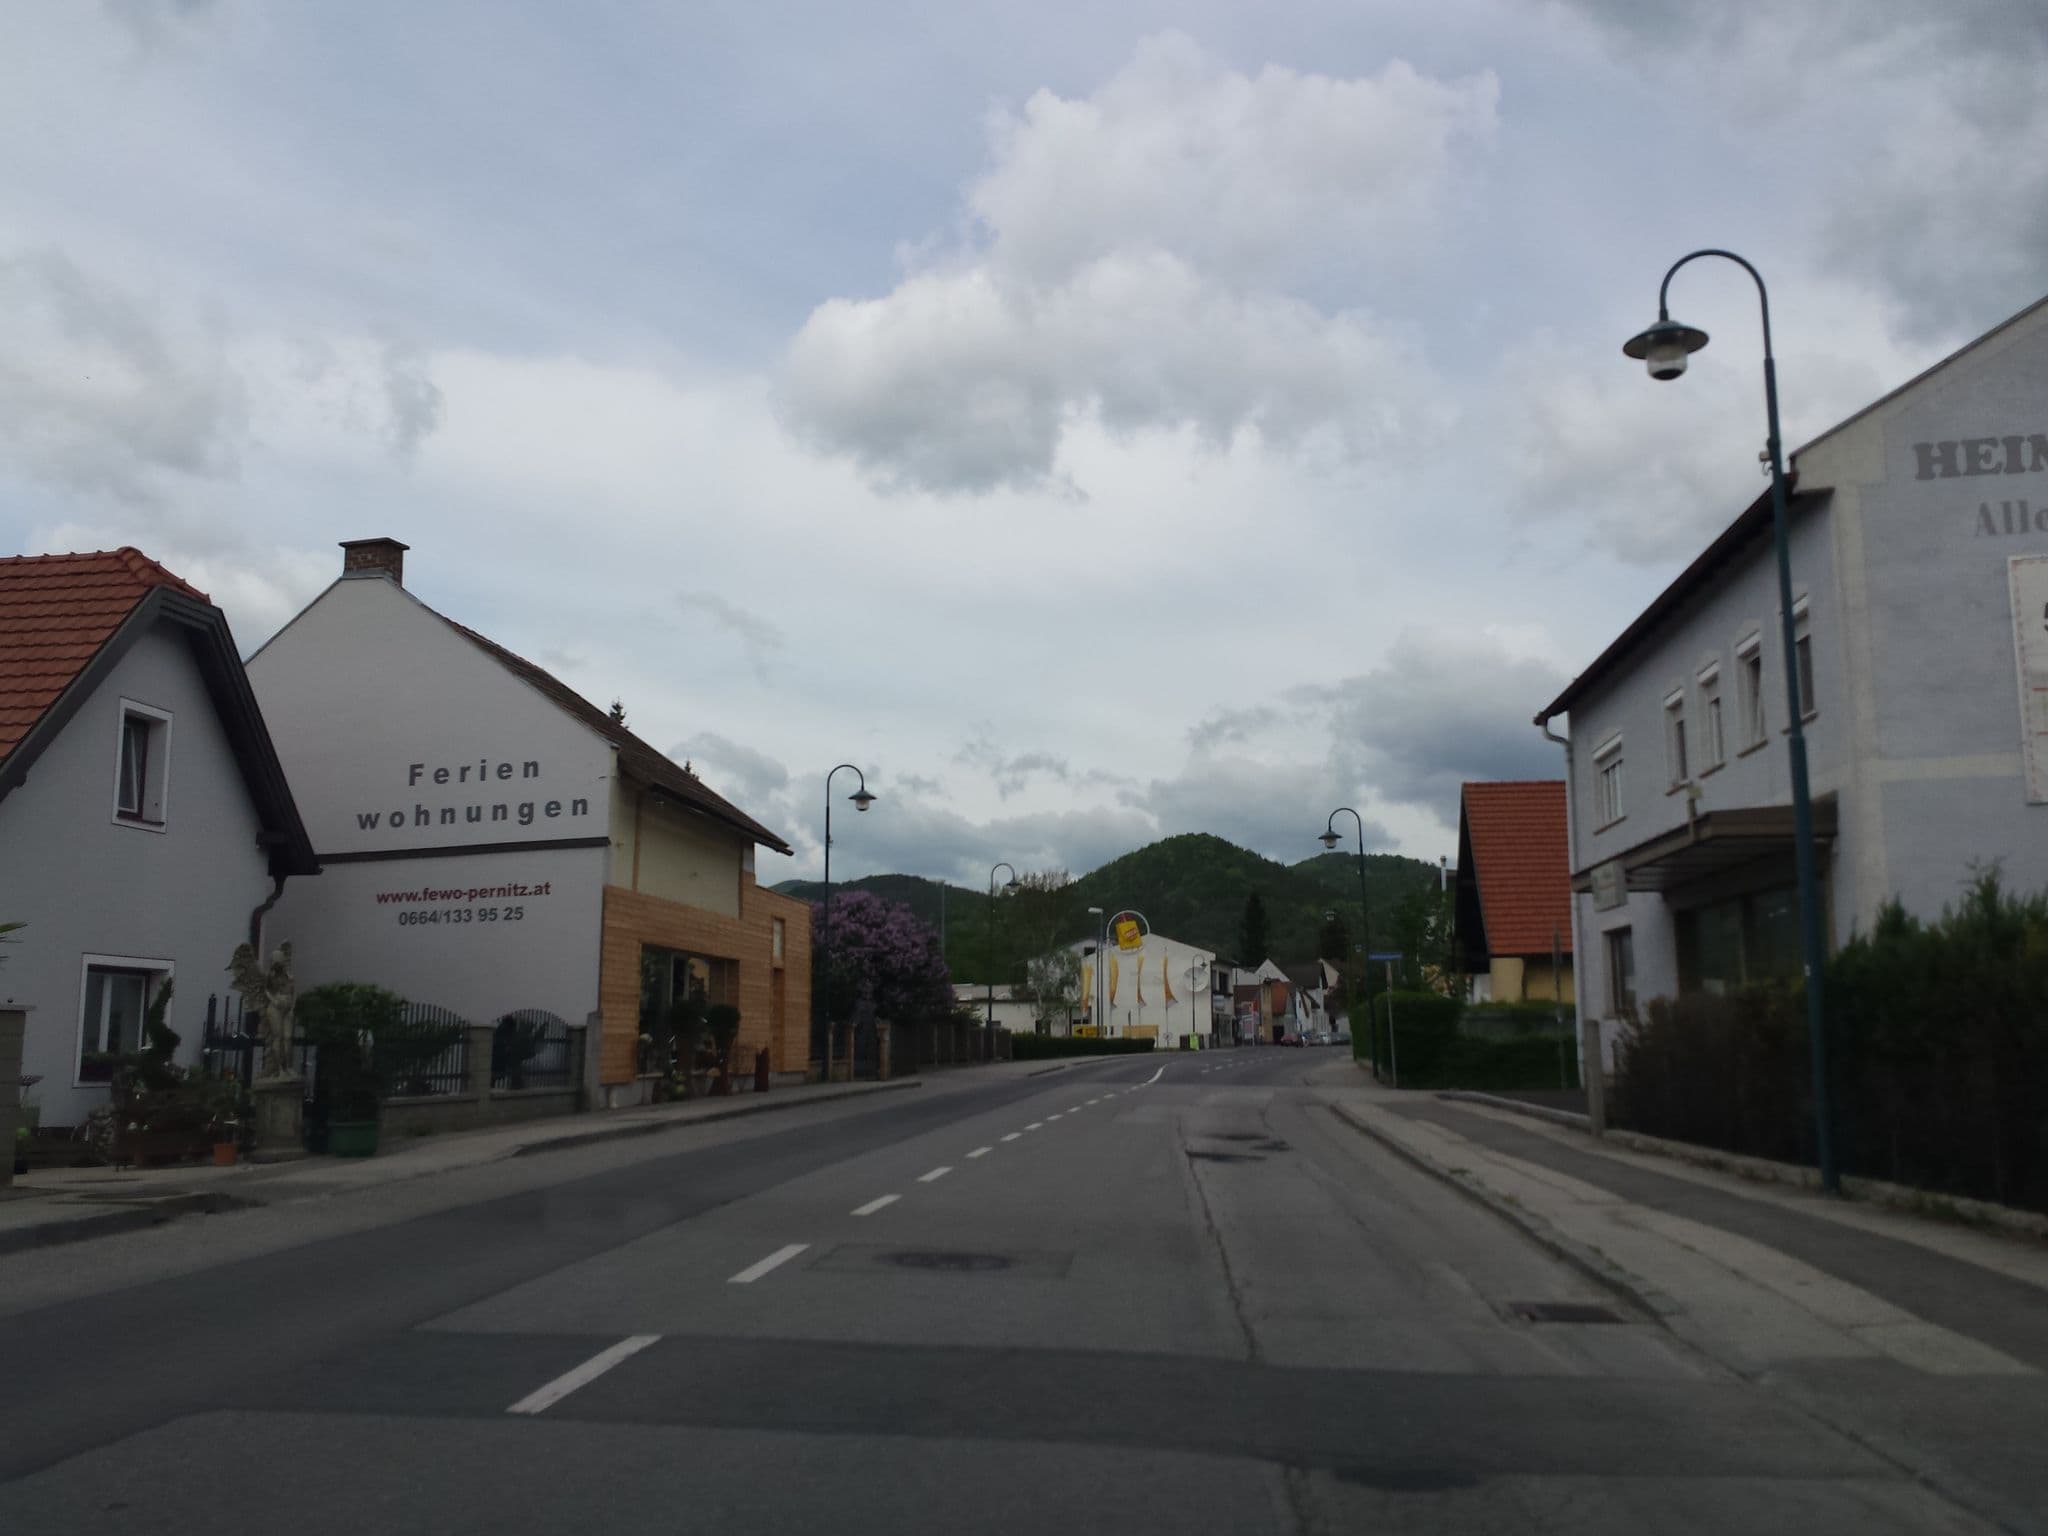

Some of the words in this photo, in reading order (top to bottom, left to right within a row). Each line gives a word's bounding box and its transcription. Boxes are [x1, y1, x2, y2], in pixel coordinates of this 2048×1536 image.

[408, 759, 539, 786] Ferien
[357, 798, 588, 829] wohnungen
[376, 881, 552, 904] www.fewo-pernitz.at
[399, 909, 472, 925] 0664/133
[479, 908, 497, 922] 95
[503, 907, 523, 920] 25
